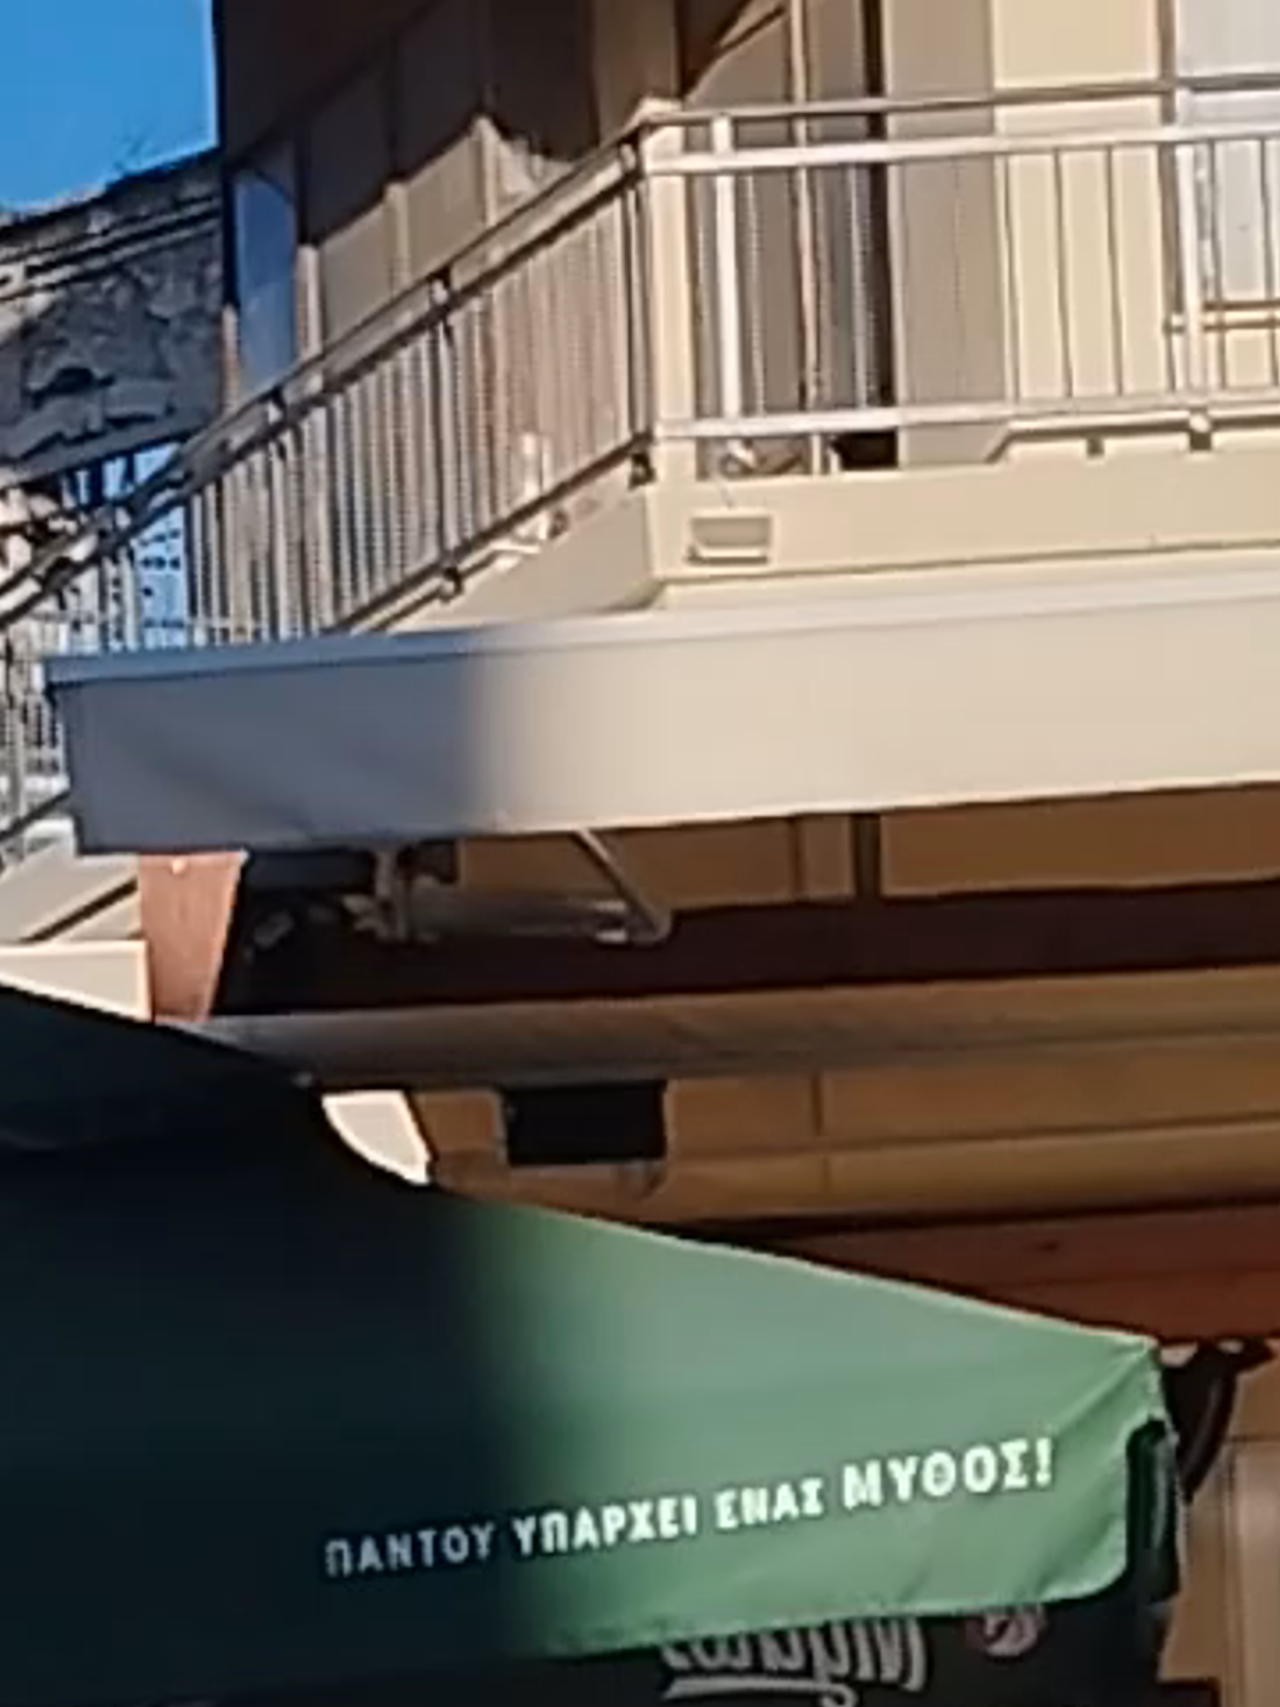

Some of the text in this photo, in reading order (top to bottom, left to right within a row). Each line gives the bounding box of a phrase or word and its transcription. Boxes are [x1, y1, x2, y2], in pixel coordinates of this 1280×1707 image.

[323, 1436, 1055, 1578] ΠΑΝΤΟΥ ΥΠΑΡΧΕΙ ΕΝΑΣ ΜΥΘΟΣ!
